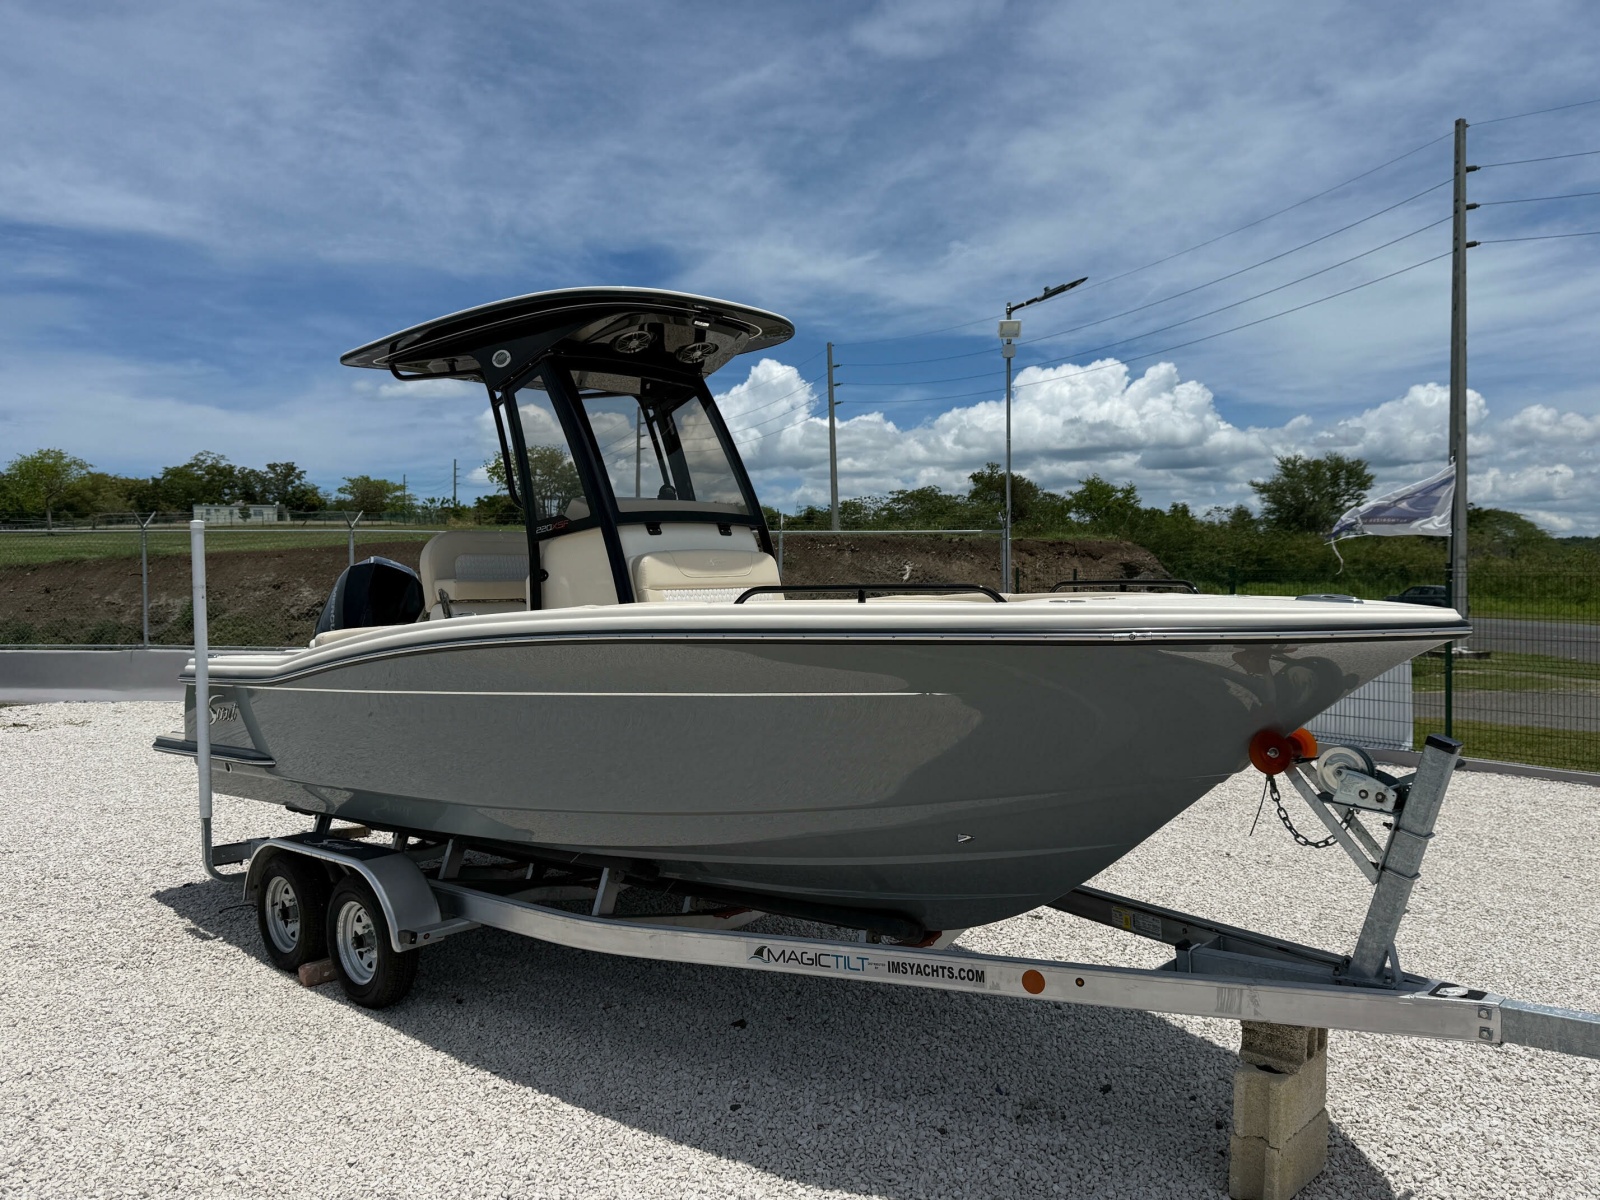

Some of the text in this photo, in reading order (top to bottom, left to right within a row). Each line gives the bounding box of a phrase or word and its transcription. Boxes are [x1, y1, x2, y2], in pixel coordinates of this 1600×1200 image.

[535, 520, 569, 534] 220XSF
[767, 947, 985, 983] MAGICTILT IMSYACHTS.COM
